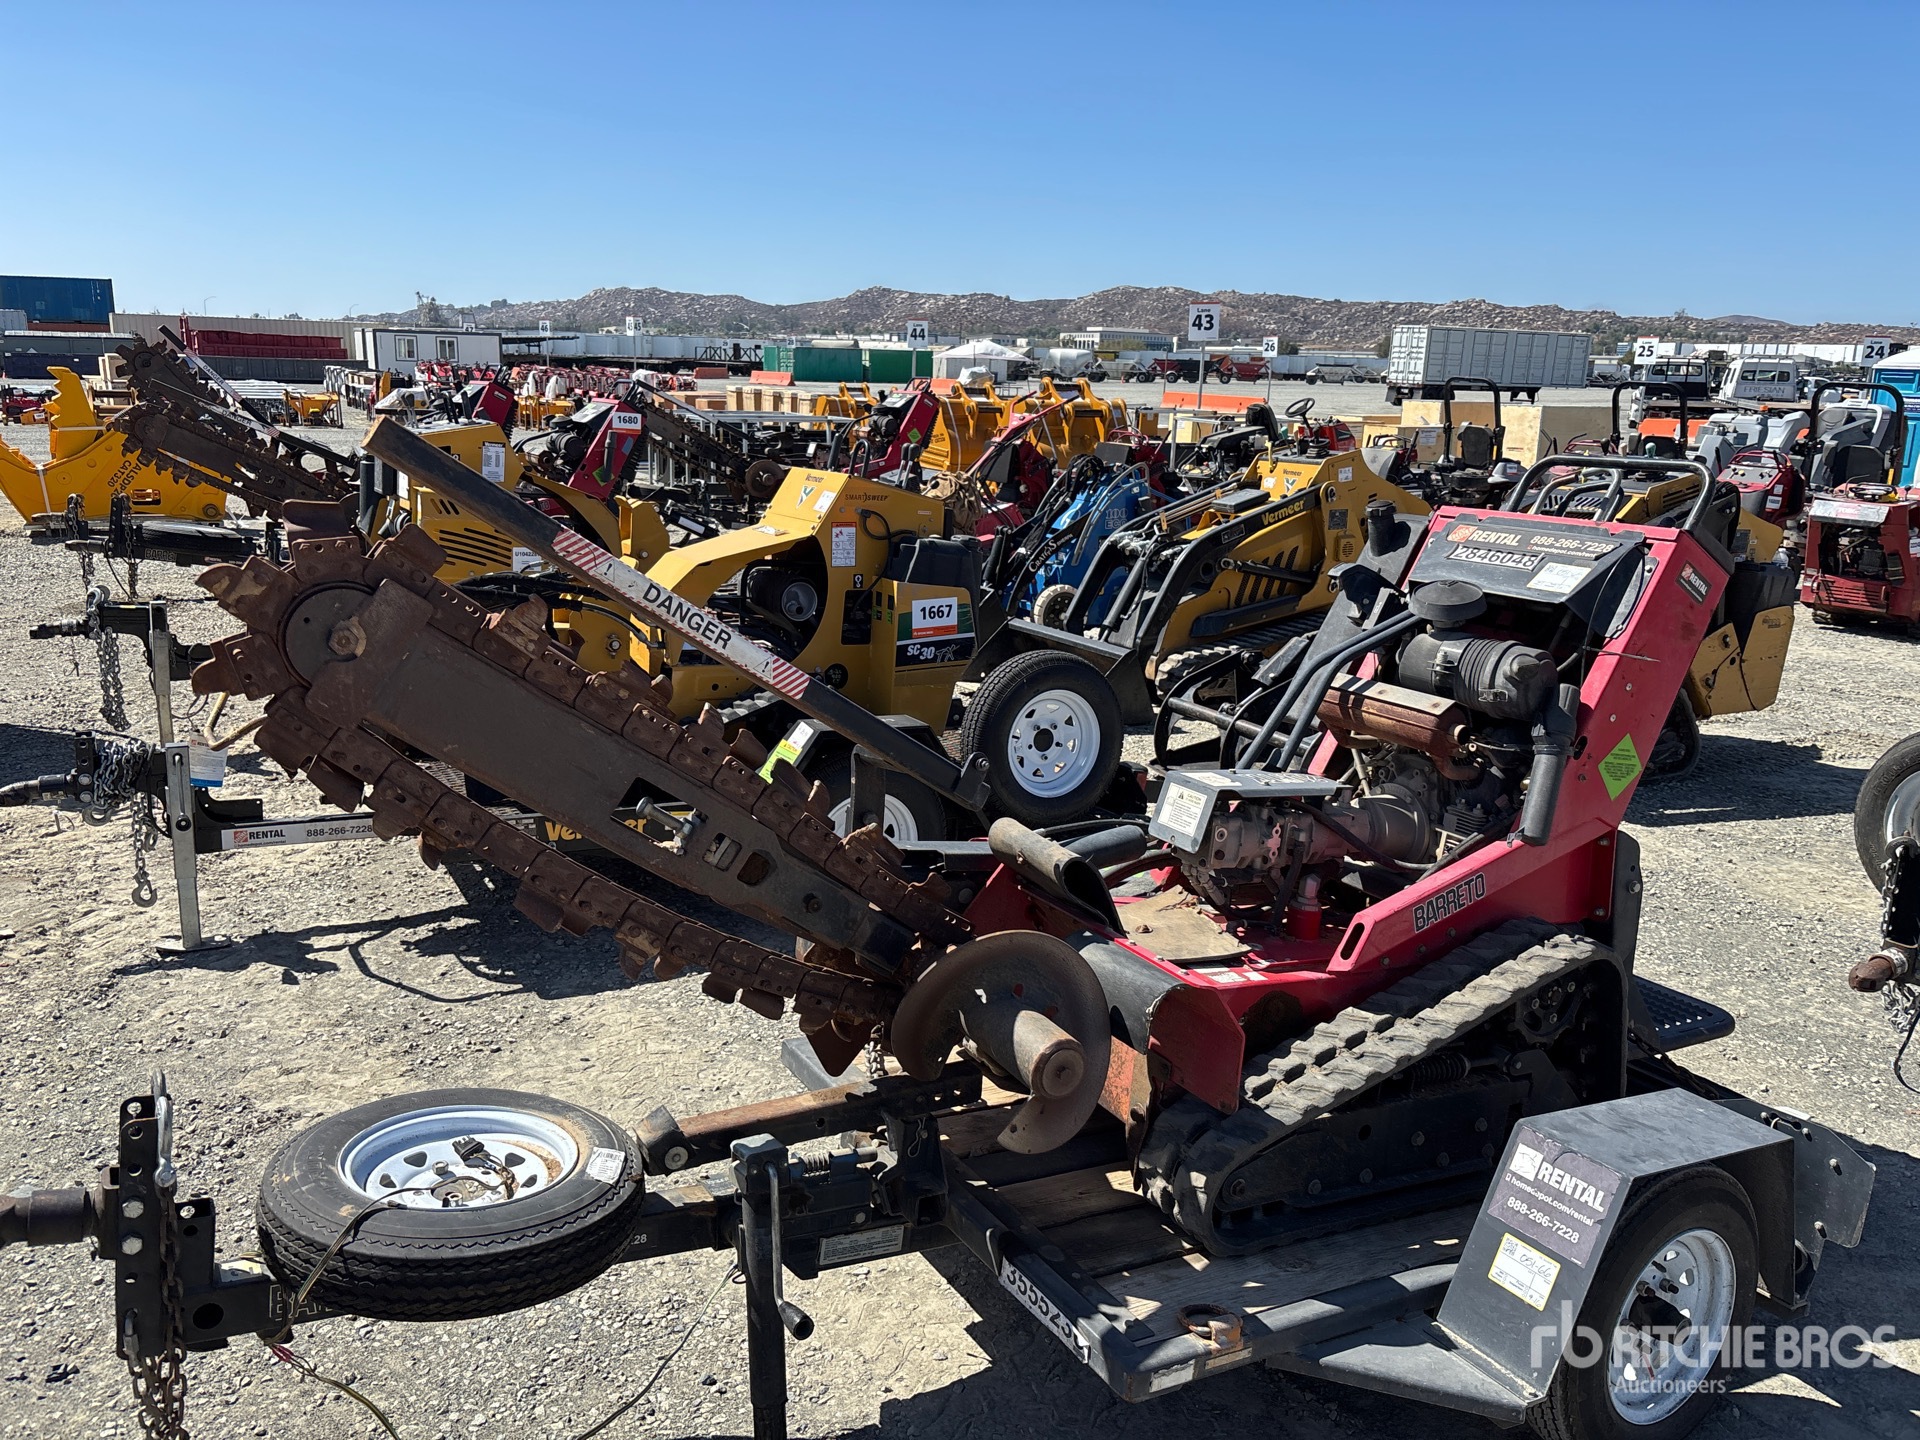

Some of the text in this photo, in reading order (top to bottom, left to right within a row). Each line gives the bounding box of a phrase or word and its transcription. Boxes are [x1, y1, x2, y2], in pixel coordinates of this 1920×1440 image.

[540, 324, 548, 333] 46
[634, 321, 641, 331] 45
[1191, 314, 1214, 331] 43
[910, 328, 926, 340] 44
[1264, 343, 1275, 352] 26
[1637, 346, 1654, 357] 25
[1865, 346, 1885, 359] 24
[203, 364, 224, 385] DANGER
[221, 409, 251, 425] DANGER
[617, 415, 639, 425] 1680
[107, 459, 132, 488] CAT320
[805, 473, 824, 483] Vermeer
[1282, 468, 1302, 477] Vermeer
[1105, 508, 1128, 519] 100
[1261, 500, 1305, 526] Vermeer
[1468, 530, 1614, 553] RENTAL 888-266-7228
[1453, 545, 1538, 568] 2846048
[1689, 572, 1708, 596] RENTAL
[642, 582, 732, 650] DANGER
[920, 604, 953, 620] 1667
[249, 825, 373, 840] RENTAL 888-266-7228
[1413, 872, 1487, 934] BARRETO
[1536, 1160, 1605, 1213] RENTAL
[1507, 1196, 1580, 1244] 888-266-7228
